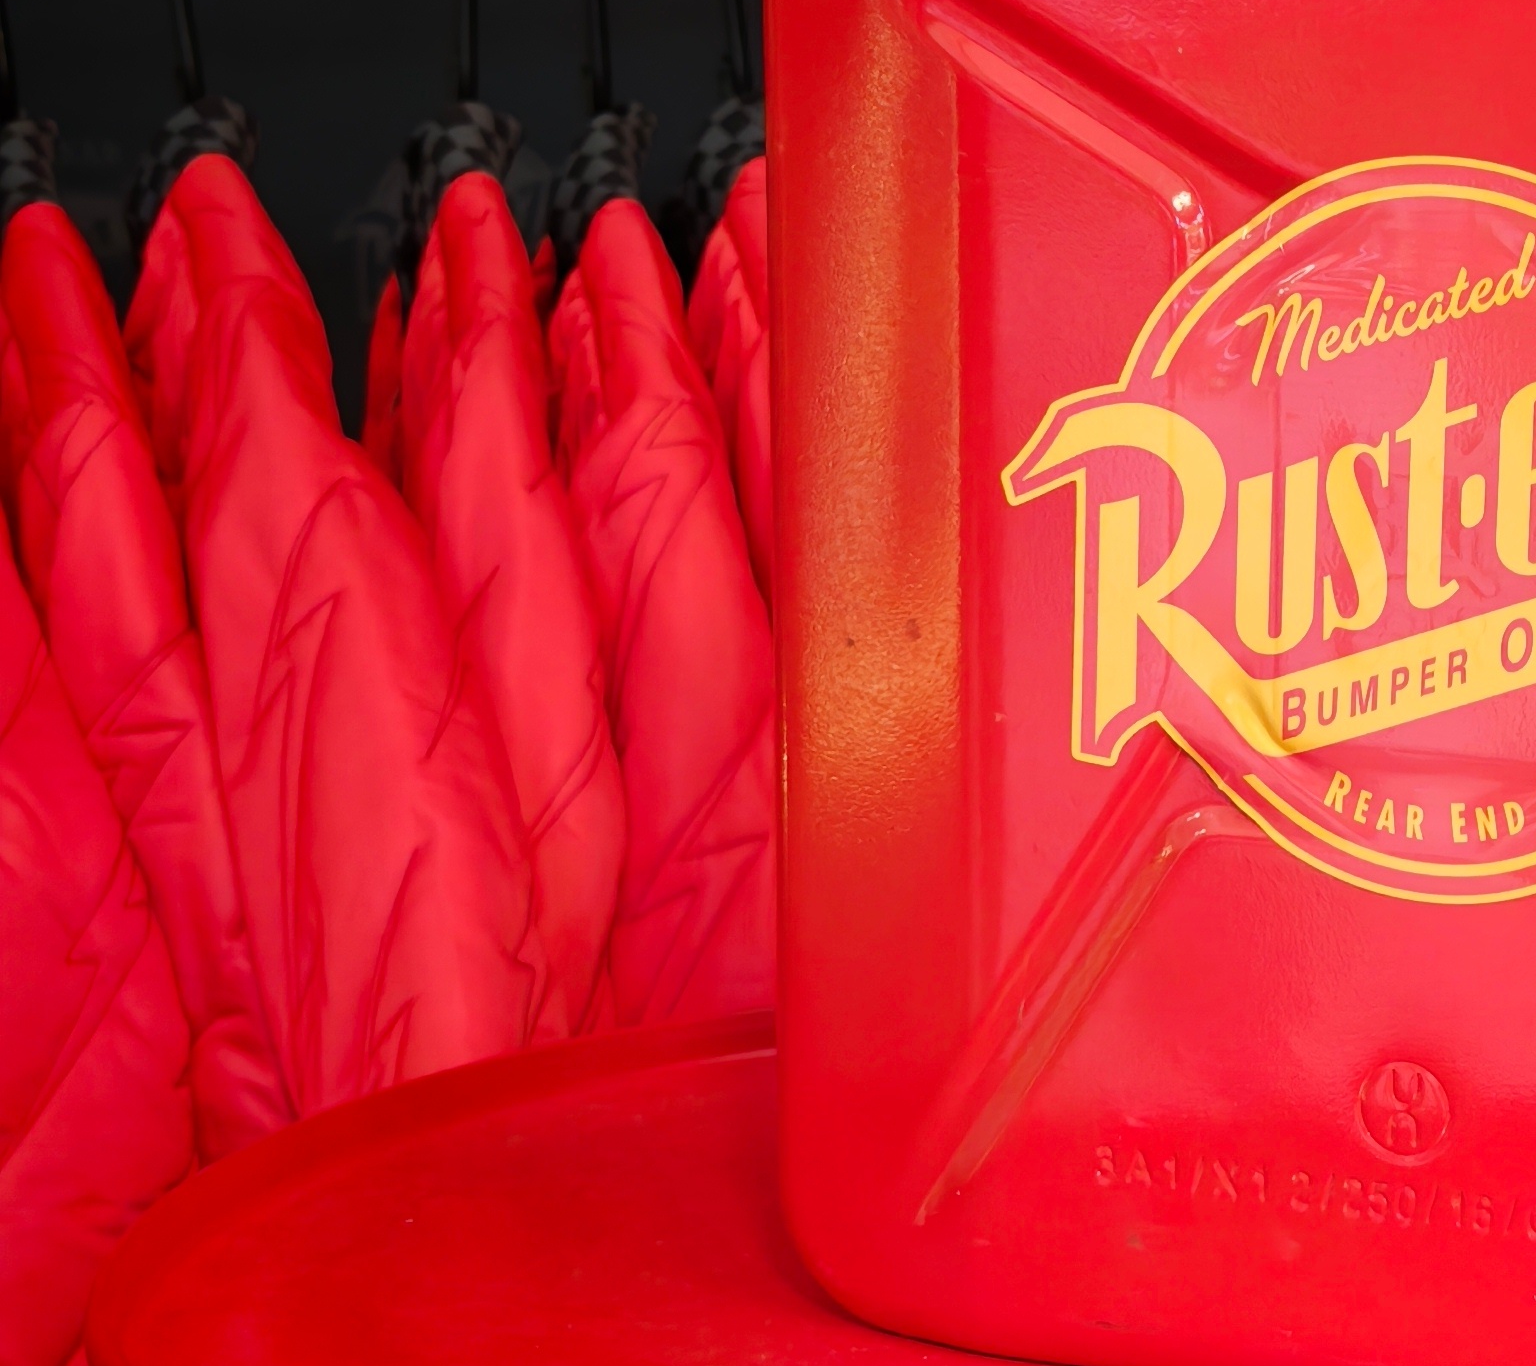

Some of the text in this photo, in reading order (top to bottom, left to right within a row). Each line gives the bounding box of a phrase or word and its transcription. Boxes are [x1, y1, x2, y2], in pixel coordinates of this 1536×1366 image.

[1236, 232, 1536, 387] Medicated
[1282, 647, 1469, 741] BUMPER
[1323, 771, 1424, 841] REAR
[1451, 801, 1526, 843] END
